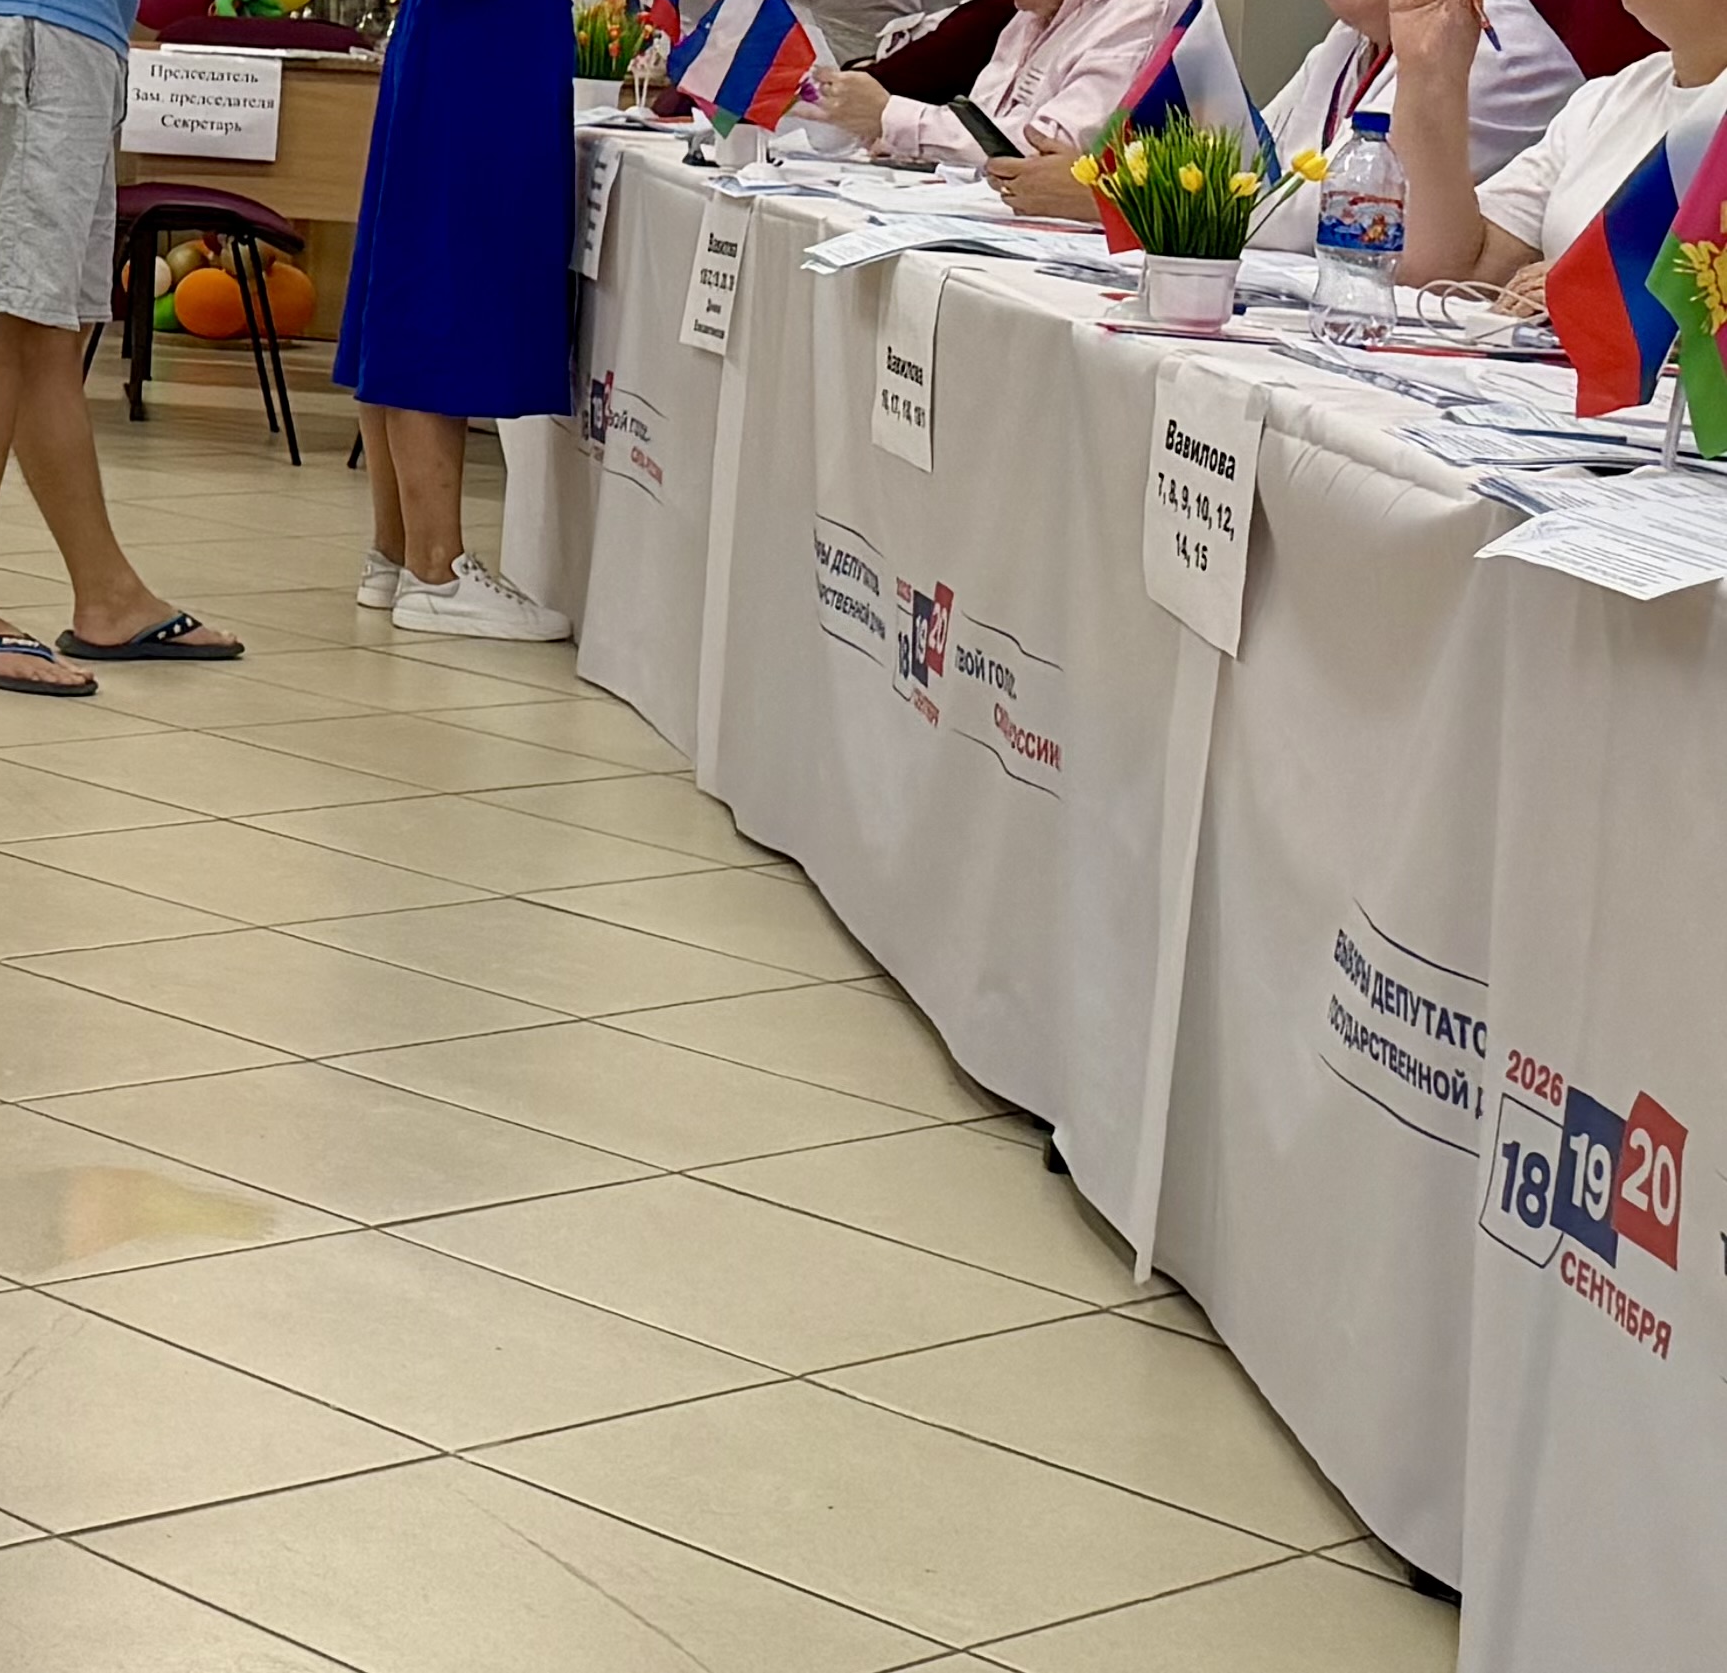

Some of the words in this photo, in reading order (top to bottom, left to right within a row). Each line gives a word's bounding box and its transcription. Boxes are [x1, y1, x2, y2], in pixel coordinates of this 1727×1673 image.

[150, 63, 259, 84] Председатель
[160, 113, 242, 135] Секретарь
[1165, 419, 1236, 482] Вавилова
[1158, 471, 1166, 505] 7,
[1168, 478, 1178, 513] 8,
[1181, 485, 1191, 520] 9,
[1196, 492, 1213, 530] 10,
[1217, 503, 1235, 542] 12,
[1176, 531, 1191, 569] 14,
[1195, 542, 1208, 571] 15
[928, 602, 948, 655] 20
[1371, 969, 1488, 1060] ДЕПУТАТО
[1505, 1049, 1564, 1107] 2026
[1501, 1140, 1551, 1229] 18
[1569, 1132, 1612, 1221] 19
[1621, 1127, 1677, 1227] 20
[1560, 1250, 1672, 1360] СЕНТЯБРЯ
